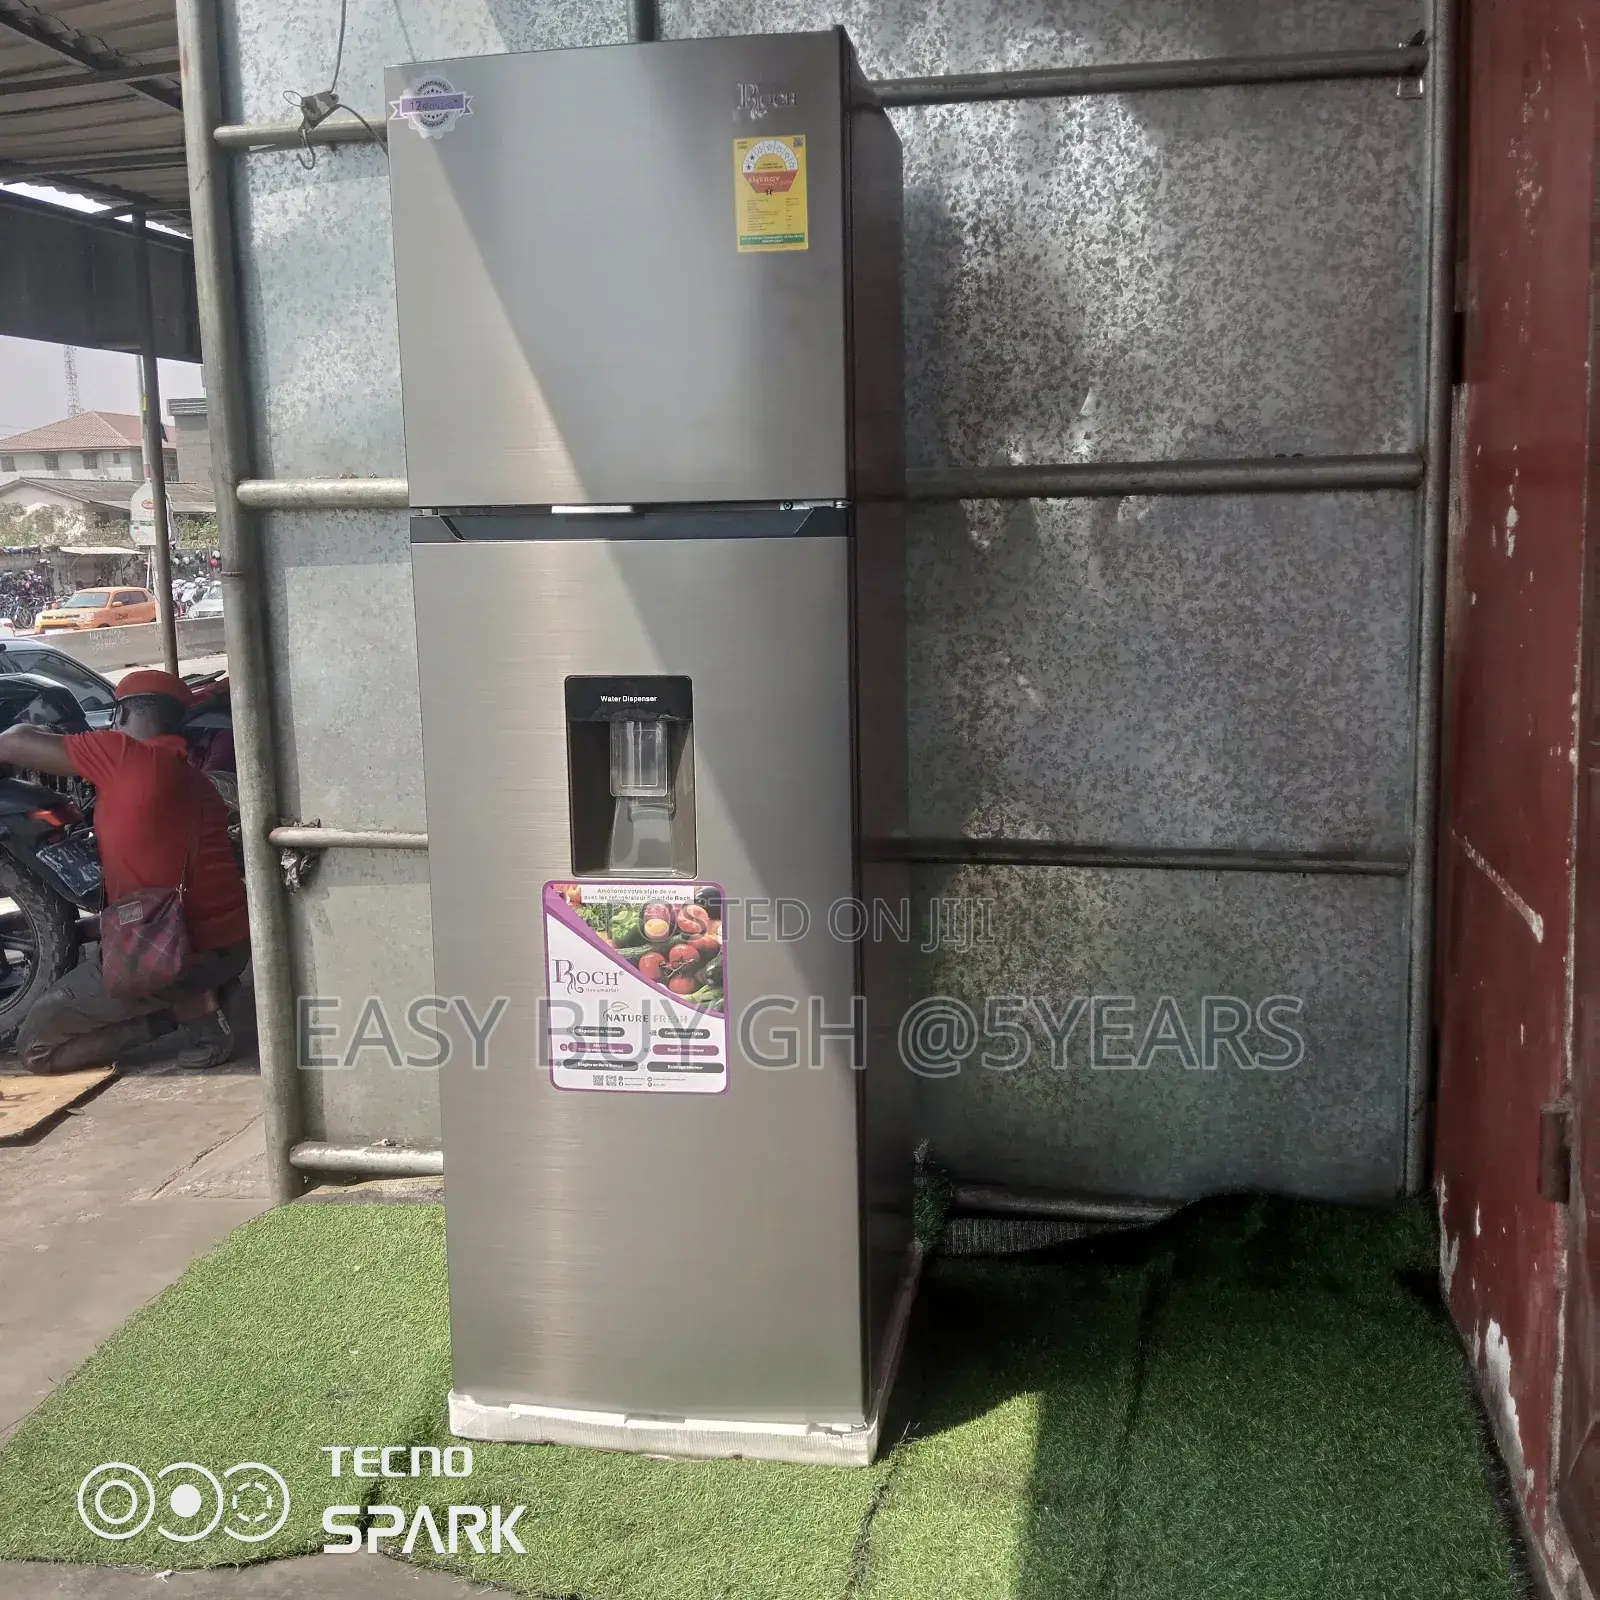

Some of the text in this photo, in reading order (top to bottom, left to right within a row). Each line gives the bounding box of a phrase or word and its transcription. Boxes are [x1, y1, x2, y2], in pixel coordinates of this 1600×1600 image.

[410, 100, 421, 111] 12
[748, 175, 781, 184] ENERGY
[600, 695, 658, 704] Water Dispenser
[643, 888, 659, 896] style
[605, 1013, 688, 1023] NATURE FRESH
